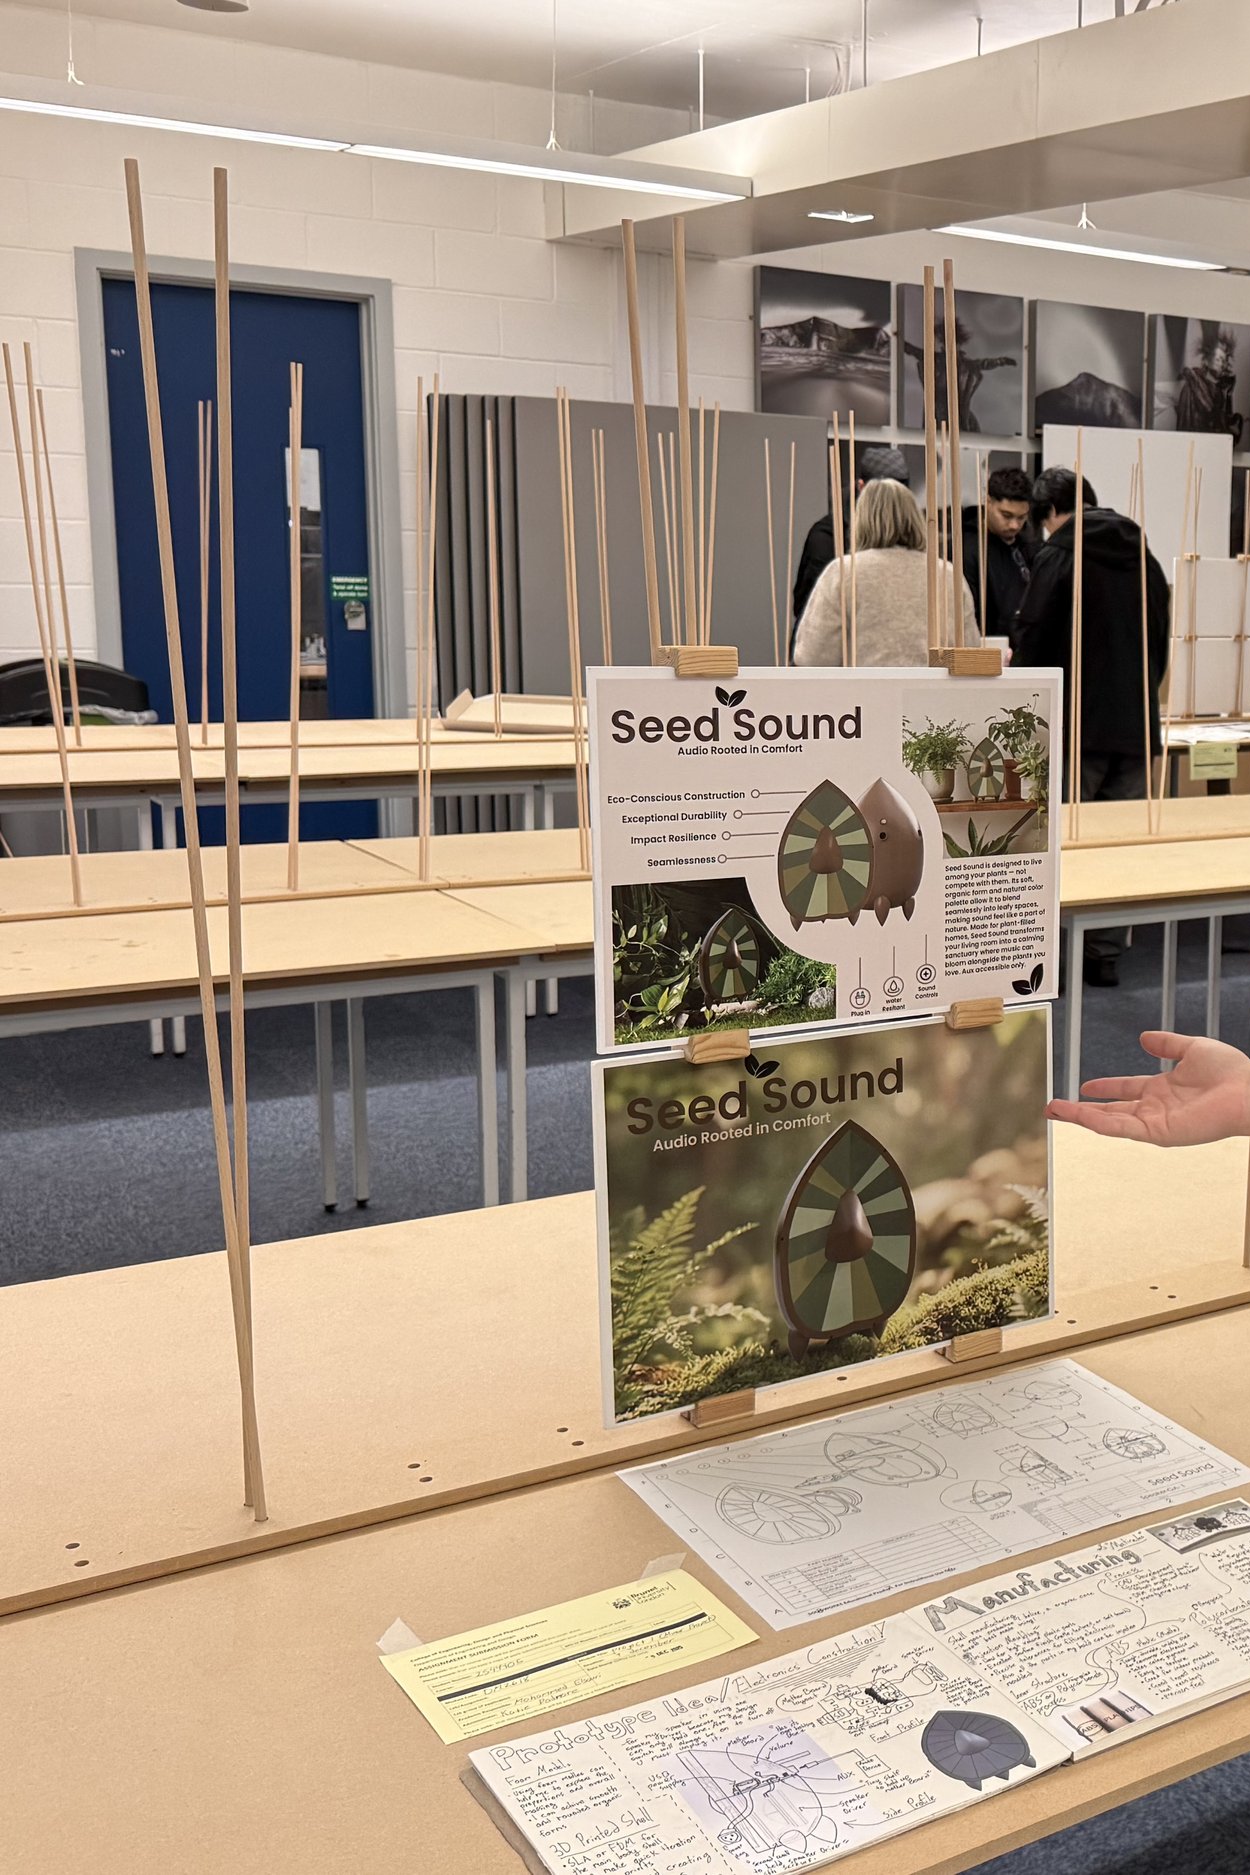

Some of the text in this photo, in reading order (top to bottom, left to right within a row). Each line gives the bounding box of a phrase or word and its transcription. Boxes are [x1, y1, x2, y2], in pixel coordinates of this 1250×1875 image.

[611, 706, 862, 743] Seed Sound
[678, 744, 803, 756] Audio Rooted in Comfort
[608, 791, 745, 804] Eco-Conscious Construction
[622, 811, 727, 824] Exceptional Durability
[631, 832, 716, 846] Impact Resilience
[647, 856, 716, 867] Seamlessness
[992, 860, 1021, 868] designed
[945, 873, 969, 881] among
[987, 870, 1007, 878] plants
[945, 881, 974, 890] compete
[945, 890, 970, 899] organic
[945, 899, 968, 908] palette
[1000, 919, 1035, 928] plant-filled
[1010, 927, 1044, 935] transforms
[945, 944, 960, 952] your
[961, 941, 979, 949] living
[945, 951, 978, 959] sanctuary
[945, 960, 966, 968] bloom
[1013, 953, 1032, 961] plants
[975, 964, 1009, 973] accessible
[627, 1057, 903, 1135] Seed Sound
[653, 1112, 831, 1152] Audio Rooted in Comfort
[1148, 1463, 1214, 1485] Seed Sound
[924, 1549, 1142, 1633] Manufacturing
[948, 1631, 967, 1645] Shell
[419, 1655, 467, 1672] ASSIGNMENT
[469, 1641, 515, 1658] SUBMISSION
[517, 1633, 538, 1643] FORM
[1106, 1641, 1130, 1658] ABS
[1022, 1695, 1043, 1711] ABS
[870, 1732, 890, 1743] Front
[897, 1717, 925, 1734] Profile
[1081, 1723, 1098, 1733] ABS
[489, 1710, 656, 1771] Prototype
[505, 1759, 571, 1786] Foam Models
[883, 1792, 936, 1819] Side Profile
[549, 1806, 654, 1857] 3D Printed Shell
[567, 1855, 591, 1868] SLA
[608, 1838, 636, 1853] FDM
[641, 1833, 656, 1841] for
[572, 1838, 662, 1875] the main body shell
[603, 1835, 696, 1873] make quick iteration
[666, 1852, 712, 1871] creating
